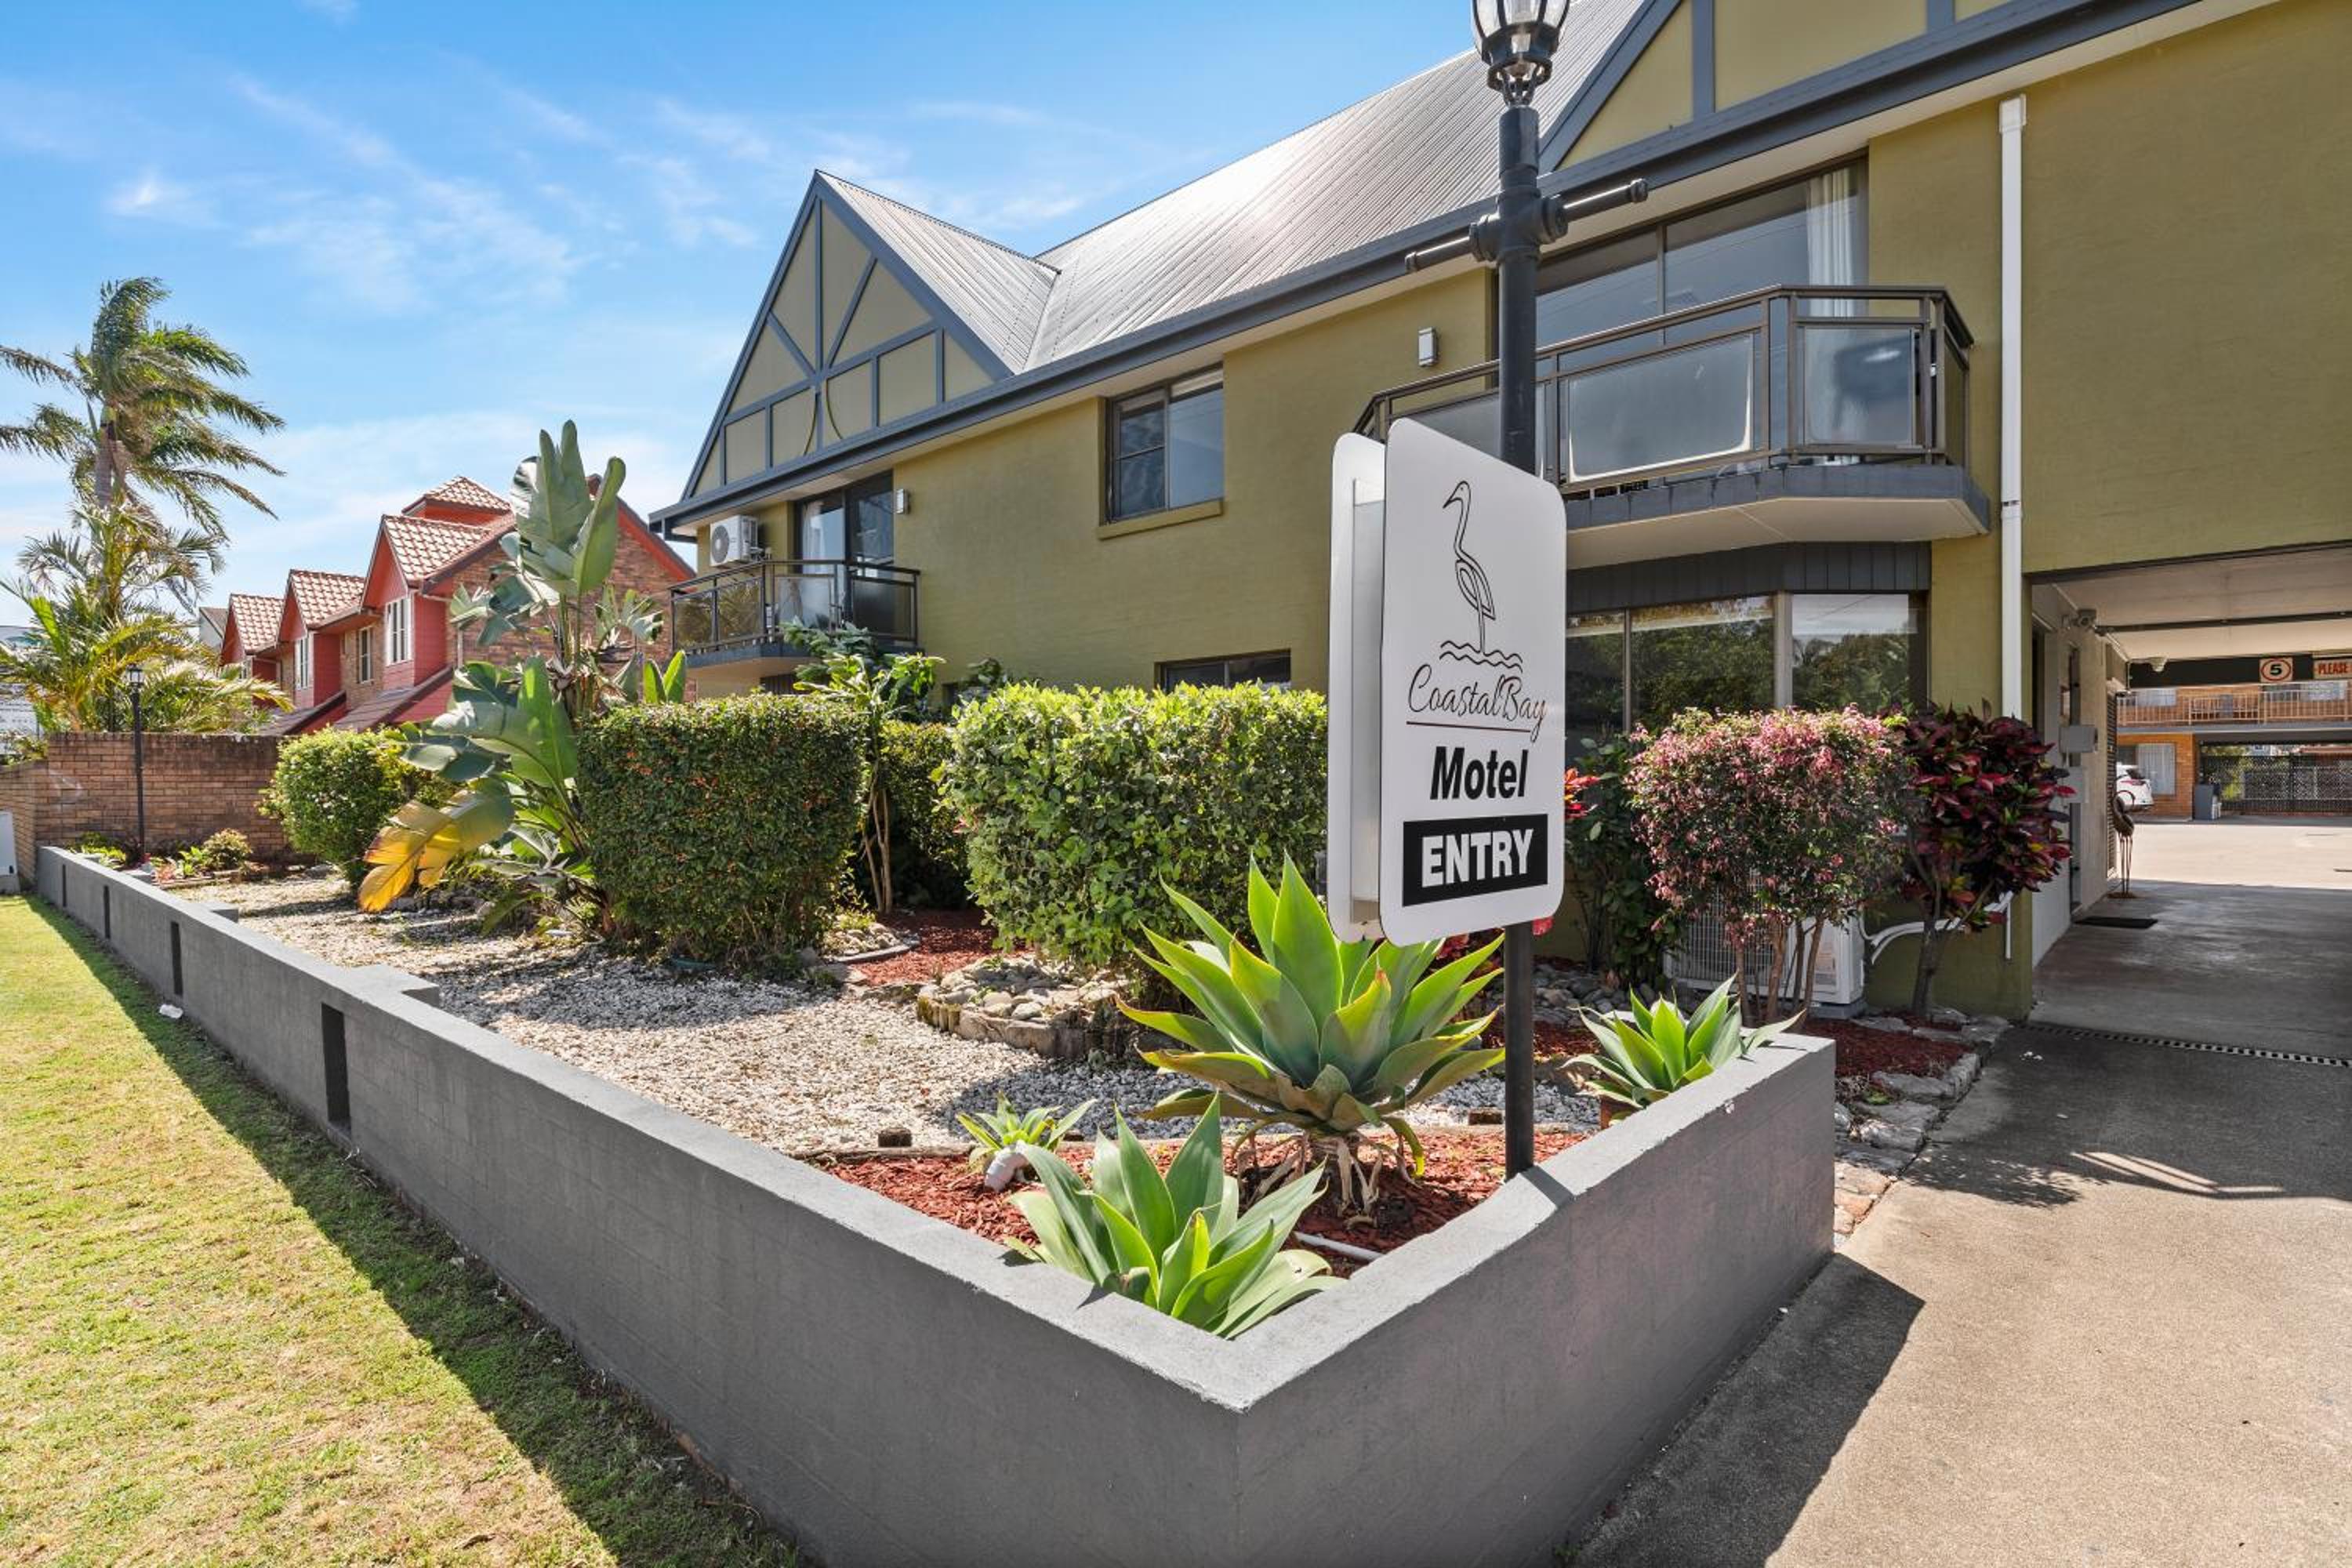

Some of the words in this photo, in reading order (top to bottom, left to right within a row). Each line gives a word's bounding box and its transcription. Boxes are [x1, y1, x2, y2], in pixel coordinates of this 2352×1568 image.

[2270, 664, 2282, 676] 5
[2318, 662, 2348, 674] PLEASE
[1430, 746, 1529, 800] Motel
[1421, 829, 1534, 887] ENTRY
